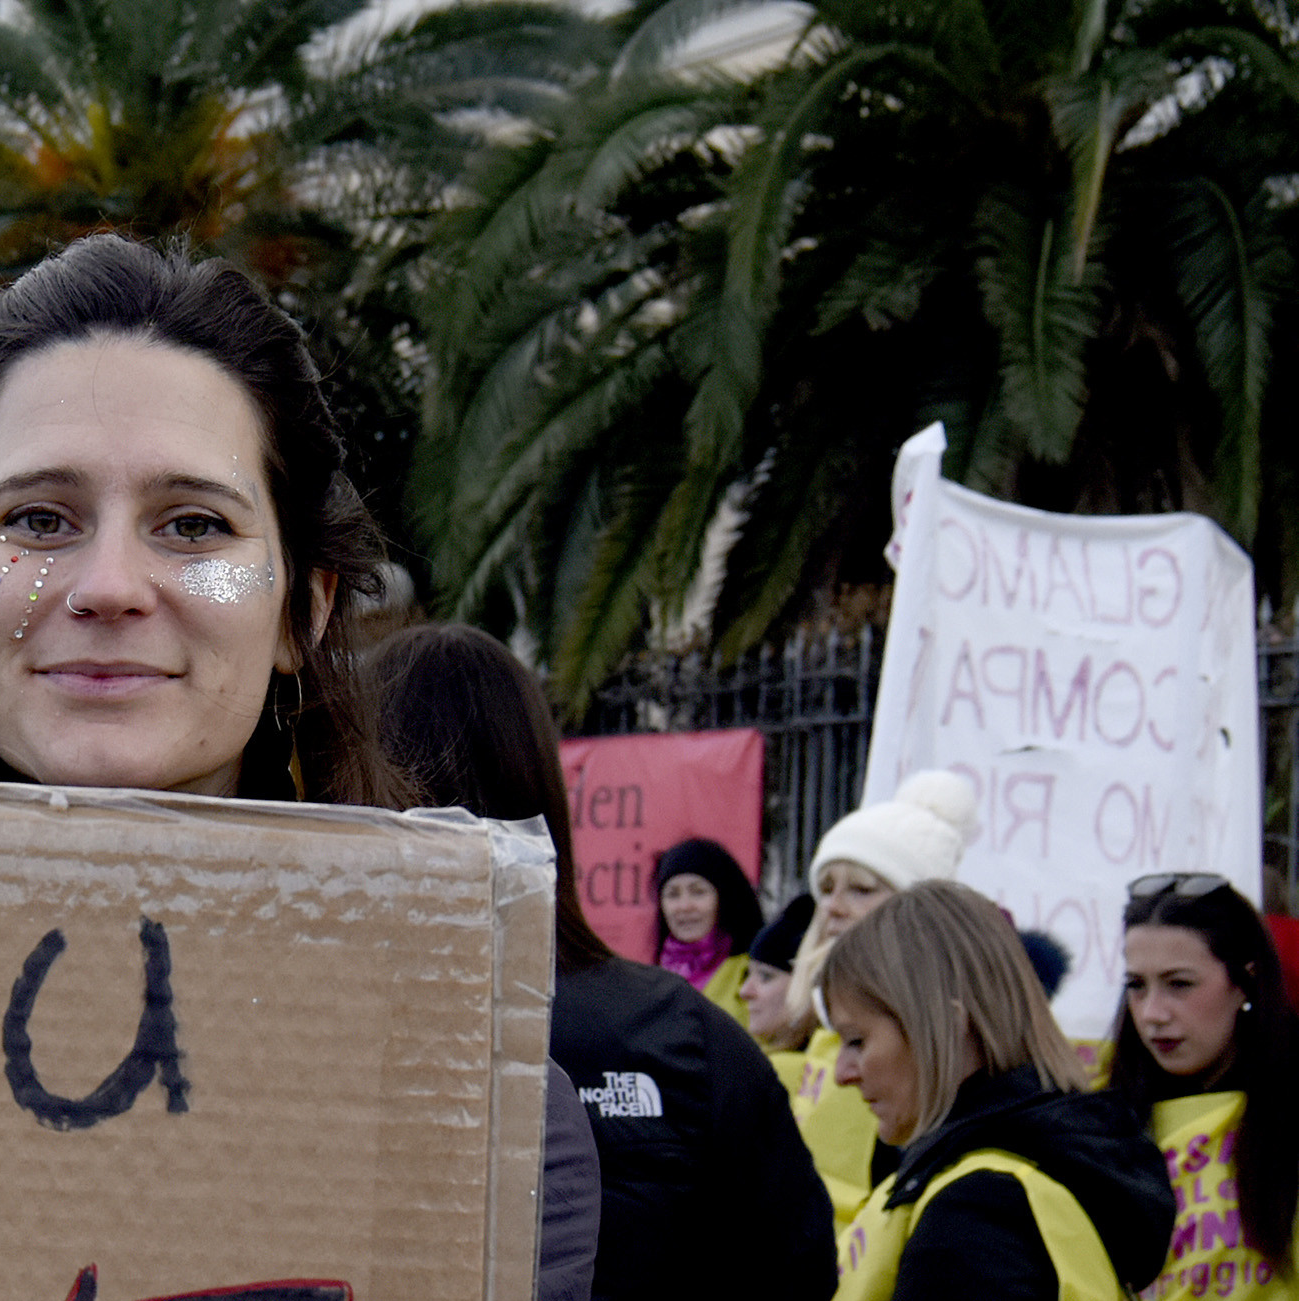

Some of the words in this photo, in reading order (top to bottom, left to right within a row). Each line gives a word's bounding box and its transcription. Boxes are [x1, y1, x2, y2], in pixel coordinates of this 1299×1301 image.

[602, 1071, 636, 1089] THE
[578, 1087, 636, 1104] NORTH
[599, 1102, 641, 1118] FACE
